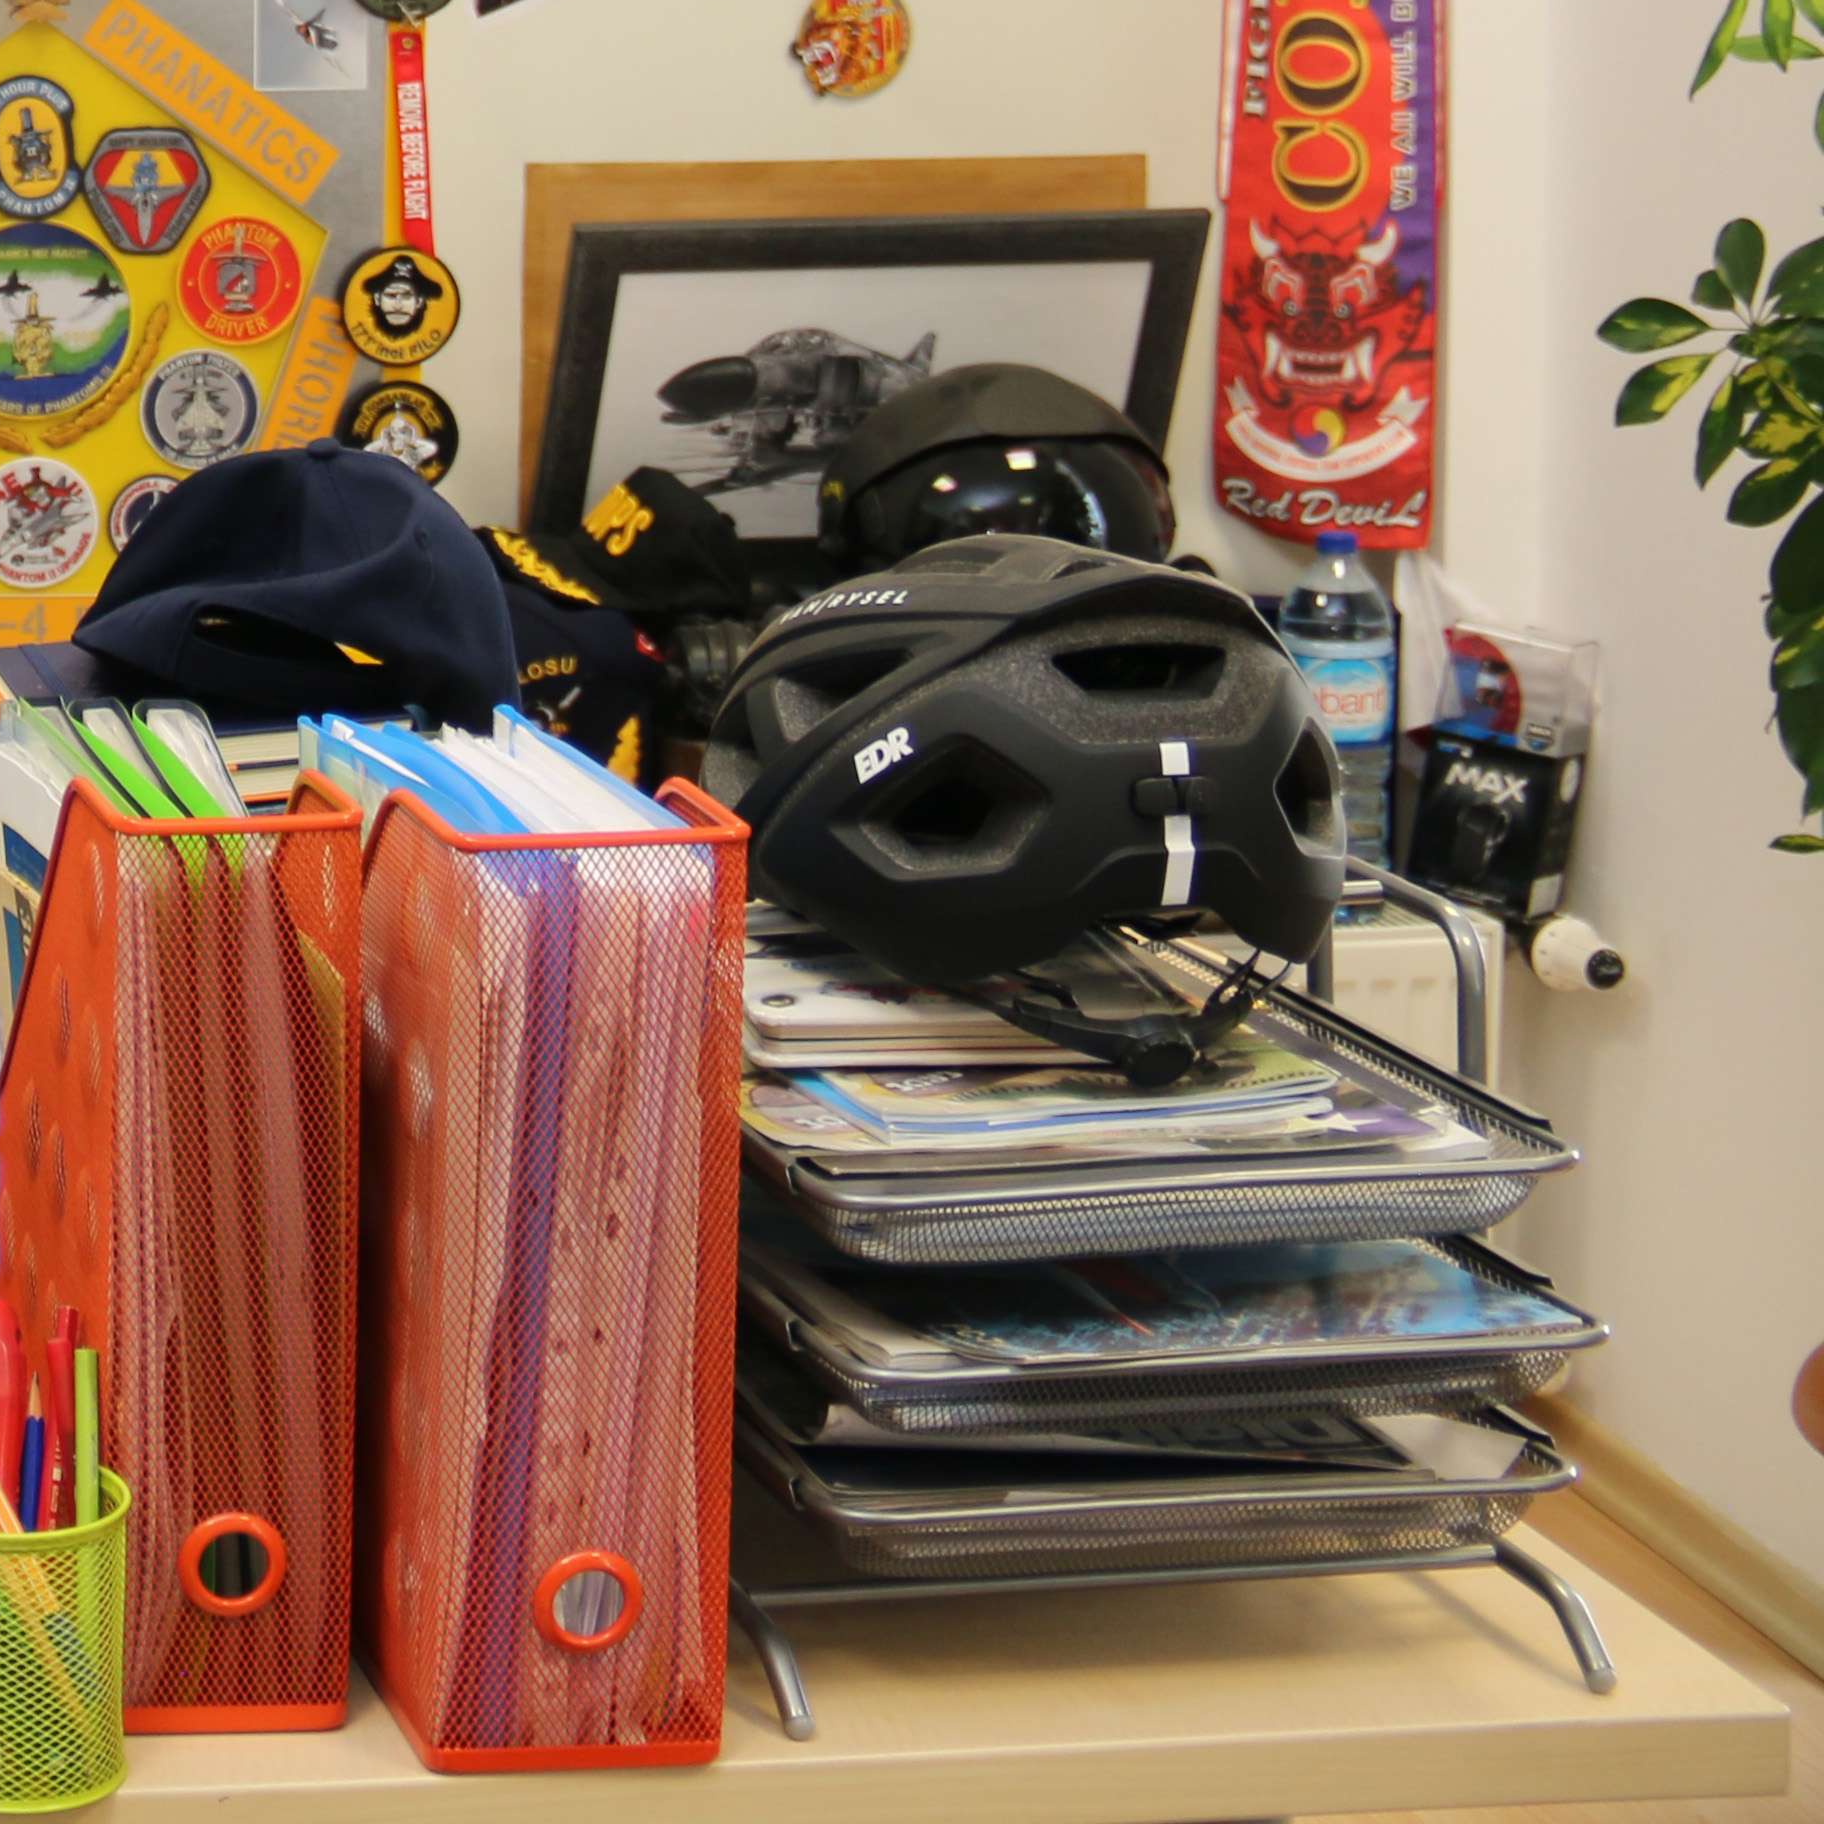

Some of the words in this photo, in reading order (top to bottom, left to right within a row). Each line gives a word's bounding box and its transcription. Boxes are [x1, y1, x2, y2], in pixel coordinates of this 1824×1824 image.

[1390, 31, 1418, 104] WILL
[0, 81, 38, 102] HOUR
[38, 82, 69, 112] PLUS
[103, 9, 320, 184] PHANATICS
[396, 80, 423, 132] REMOVE
[400, 131, 427, 181] BEFORE
[403, 178, 429, 221] FLIGHT
[1390, 167, 1418, 212] WE
[201, 222, 281, 250] PHANTOM
[205, 314, 269, 338] DRIVER
[1221, 477, 1295, 522] Red
[1313, 686, 1385, 716] bant
[852, 726, 914, 785] EDR
[1443, 762, 1529, 804] MAX
